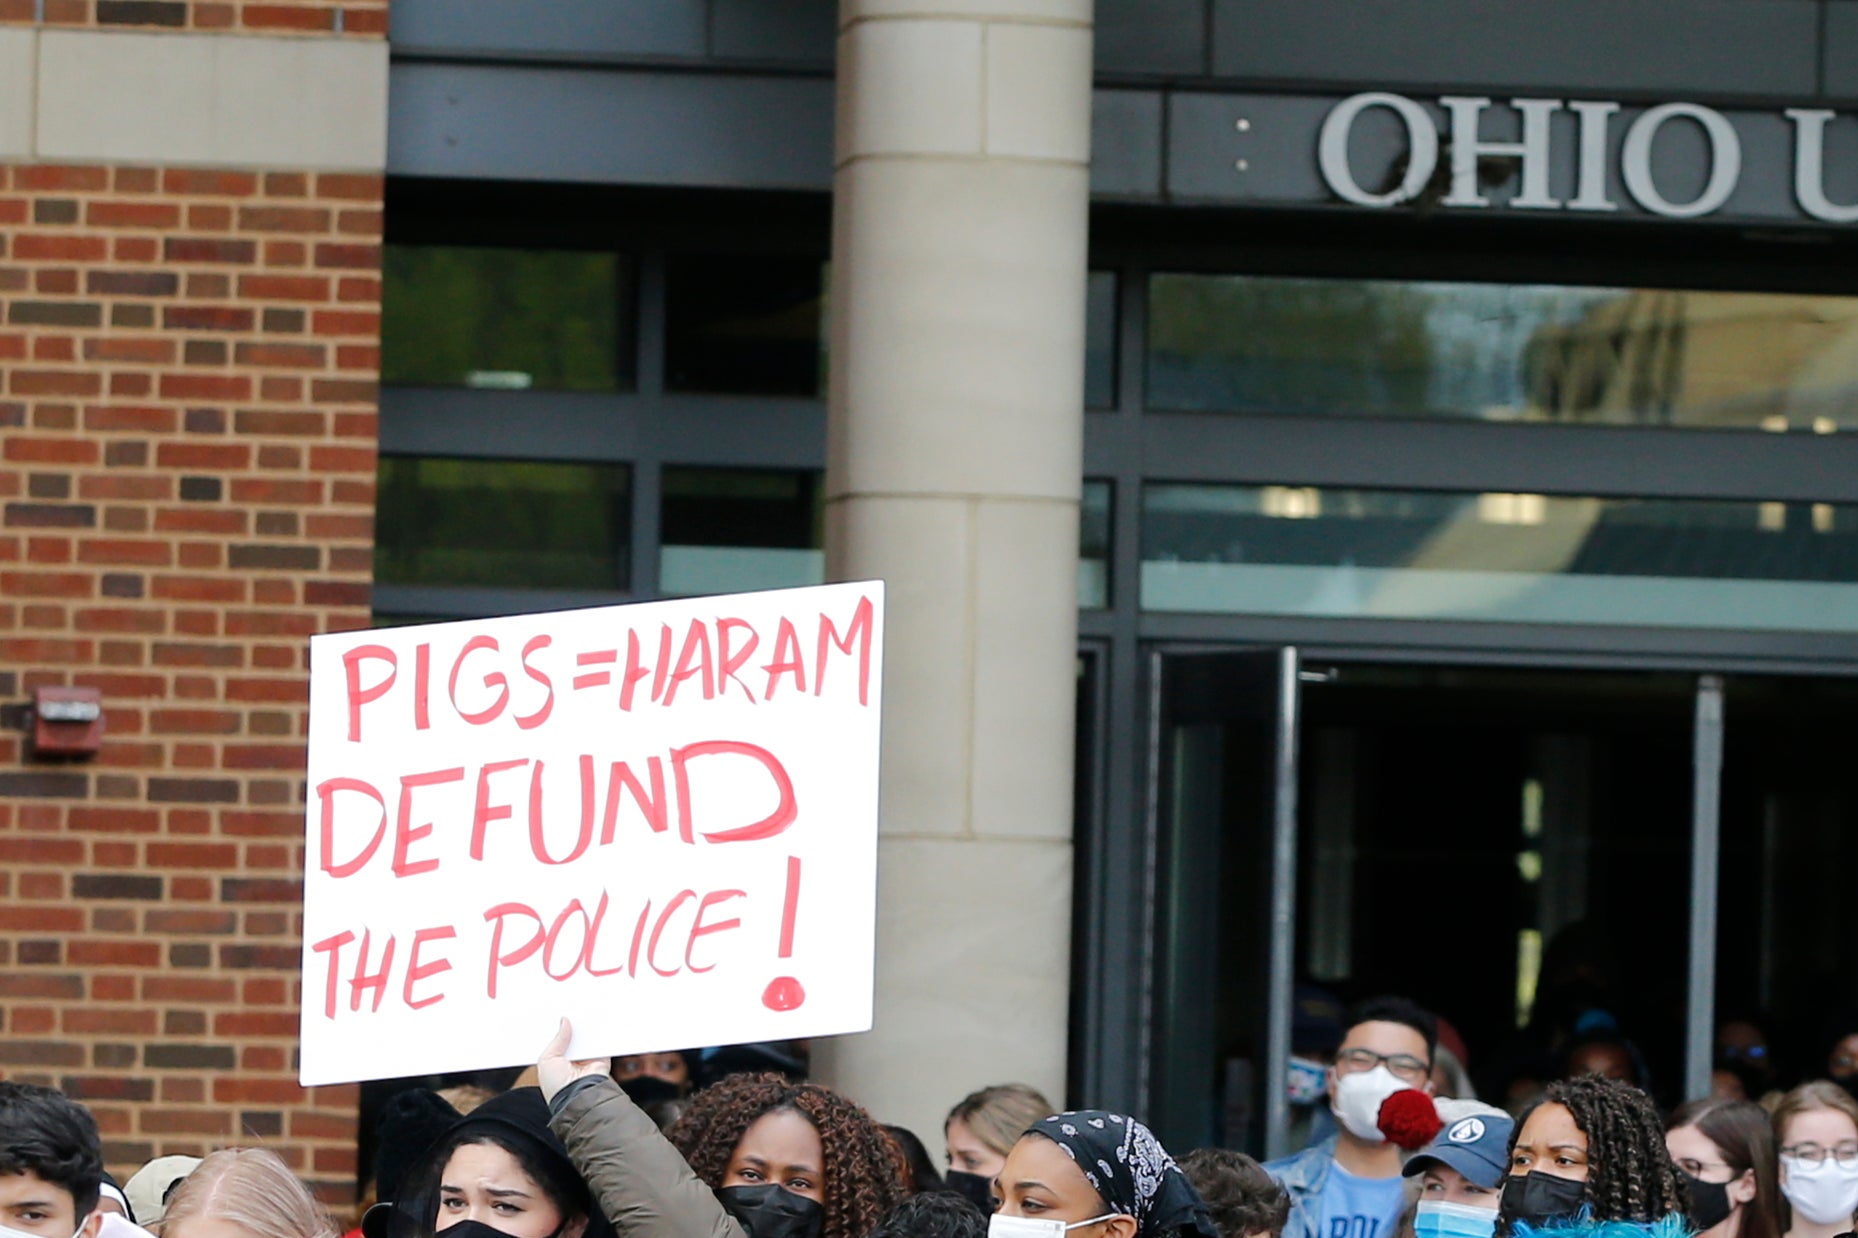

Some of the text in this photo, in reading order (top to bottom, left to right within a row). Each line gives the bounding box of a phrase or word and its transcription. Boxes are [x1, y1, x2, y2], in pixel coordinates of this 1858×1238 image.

[1318, 92, 1742, 218] OHIO
[315, 738, 800, 881] DEFUND
[310, 922, 458, 1022] THE
[482, 885, 748, 1001] POLICE
